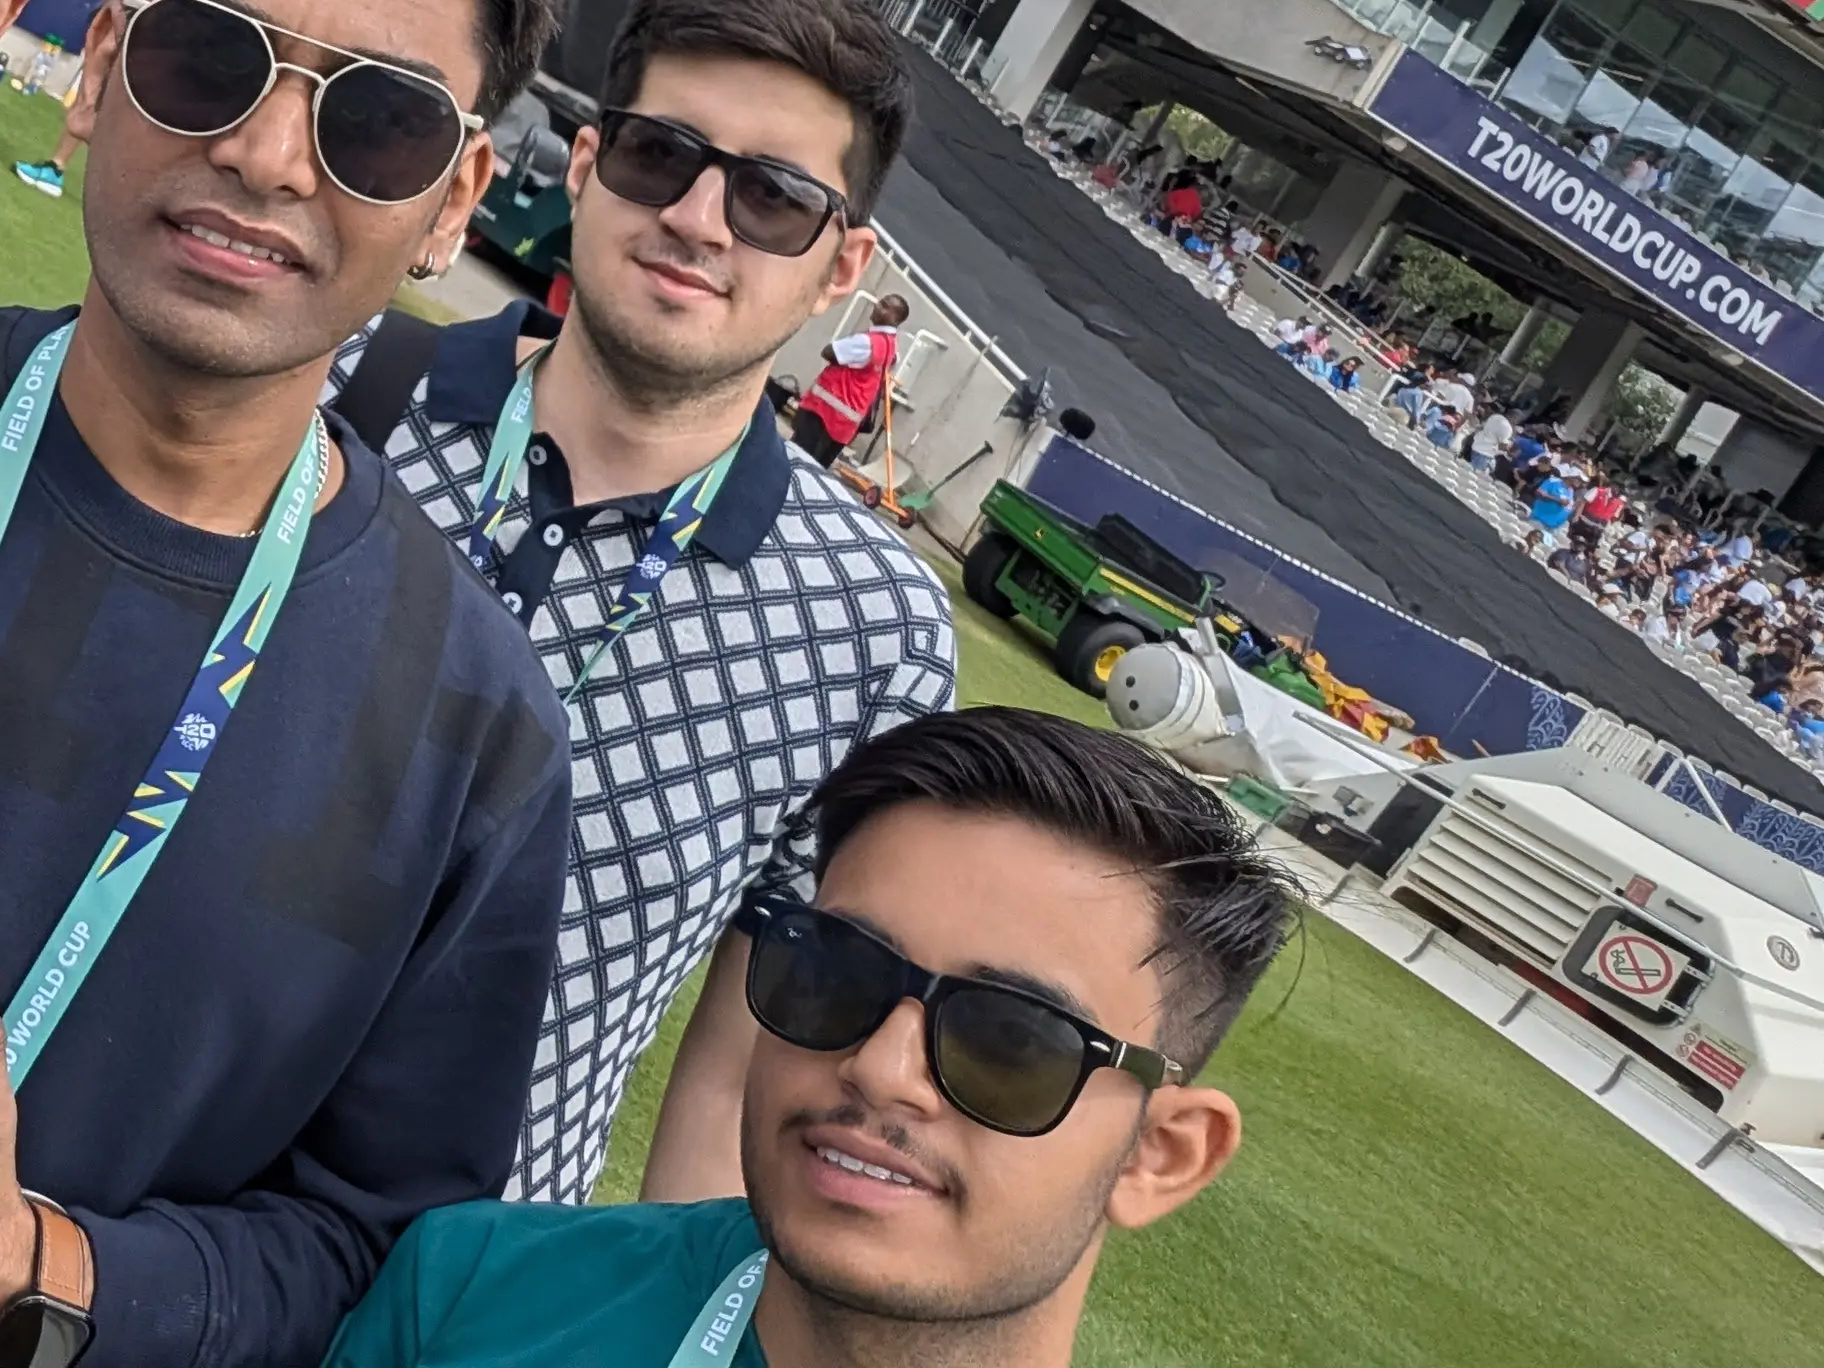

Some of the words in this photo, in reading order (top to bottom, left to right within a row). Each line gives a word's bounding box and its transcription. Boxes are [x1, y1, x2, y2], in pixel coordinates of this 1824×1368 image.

[1466, 116, 1783, 346] T20WORLDCUP.COM
[1, 395, 35, 452] FIELD
[24, 364, 46, 391] OF
[277, 487, 306, 544] FIELD
[301, 455, 319, 485] OF
[7, 968, 65, 1047] WORLD
[58, 920, 91, 967] CUP
[700, 1293, 744, 1357] FIELD
[738, 1265, 762, 1289] OF
